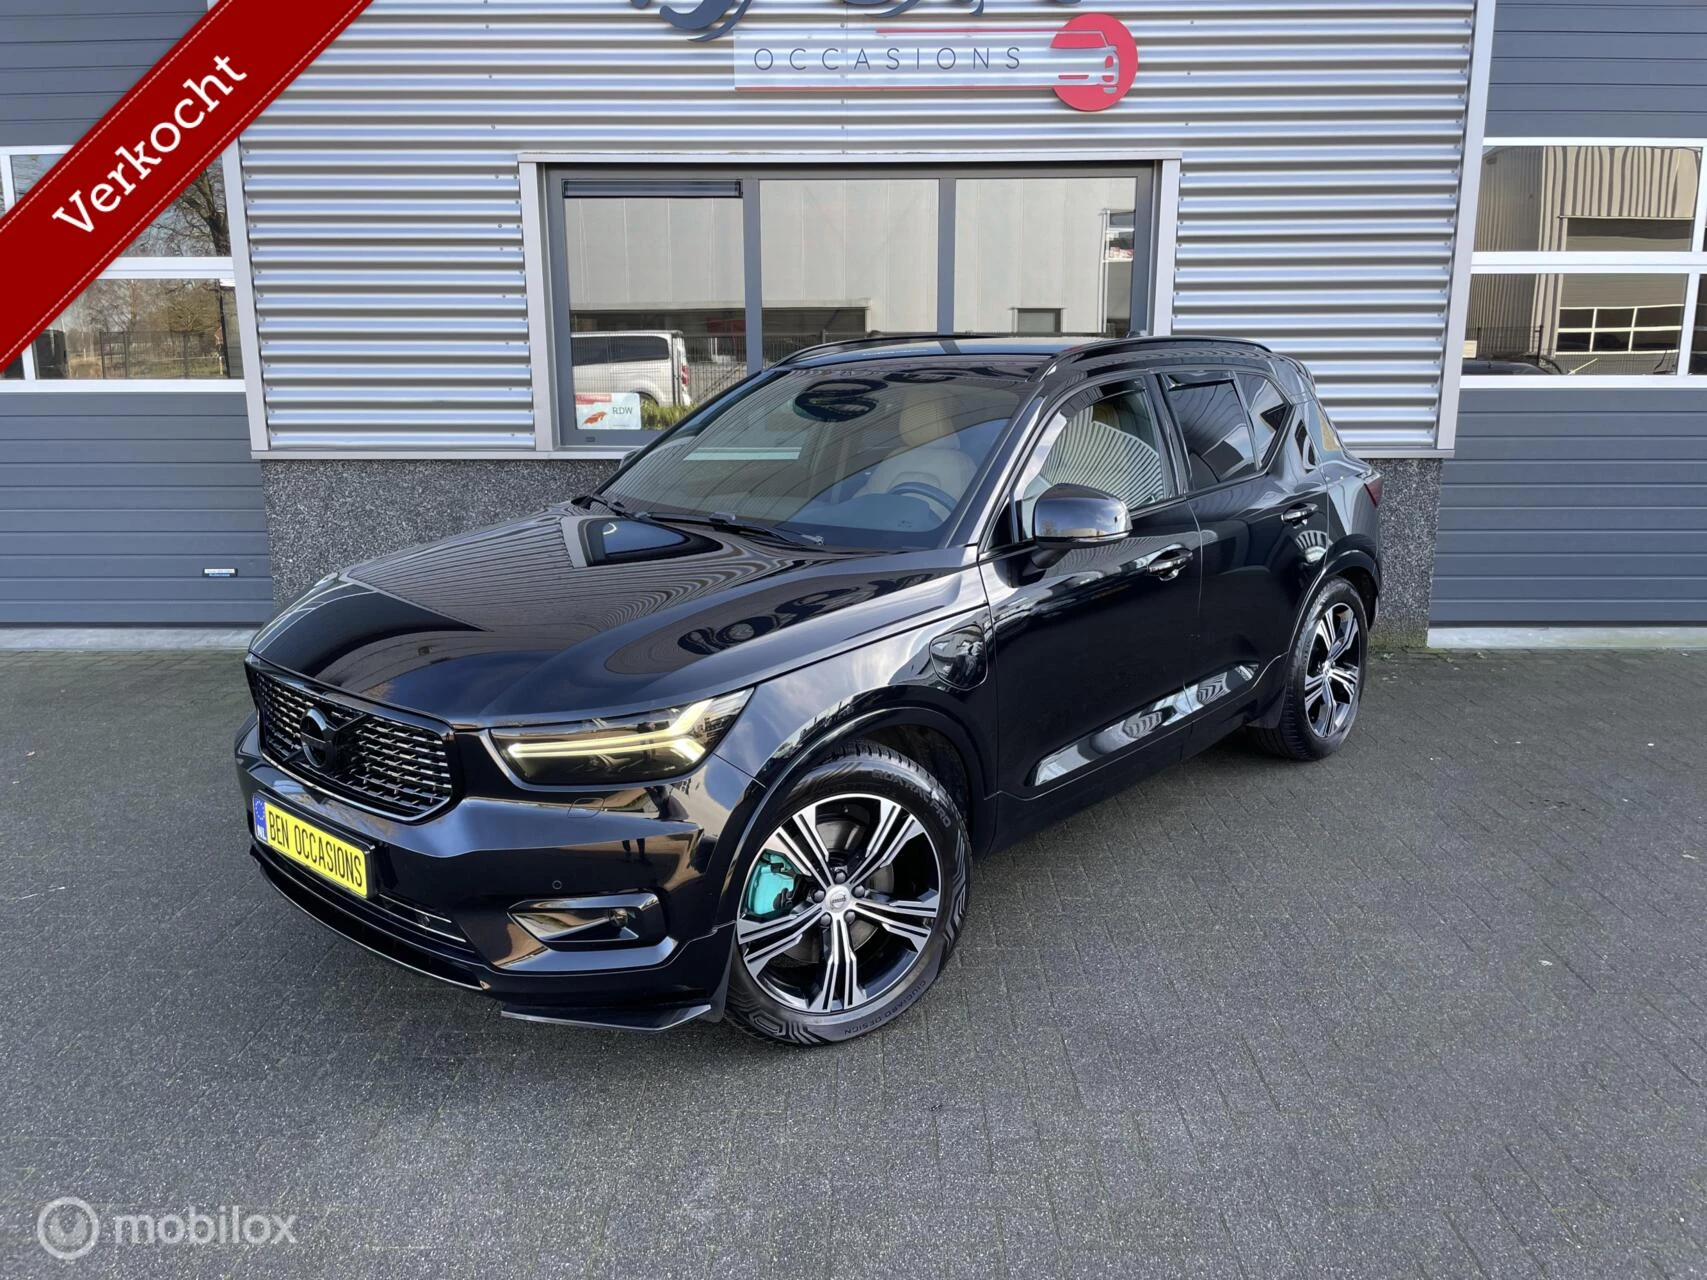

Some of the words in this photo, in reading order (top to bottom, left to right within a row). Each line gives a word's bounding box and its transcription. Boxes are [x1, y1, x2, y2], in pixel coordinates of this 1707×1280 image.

[753, 46, 1022, 72] OCCASIONS
[611, 406, 634, 416] RDW
[930, 800, 952, 828] PRO
[268, 810, 290, 850] BEN
[293, 825, 363, 888] OCCASIONS
